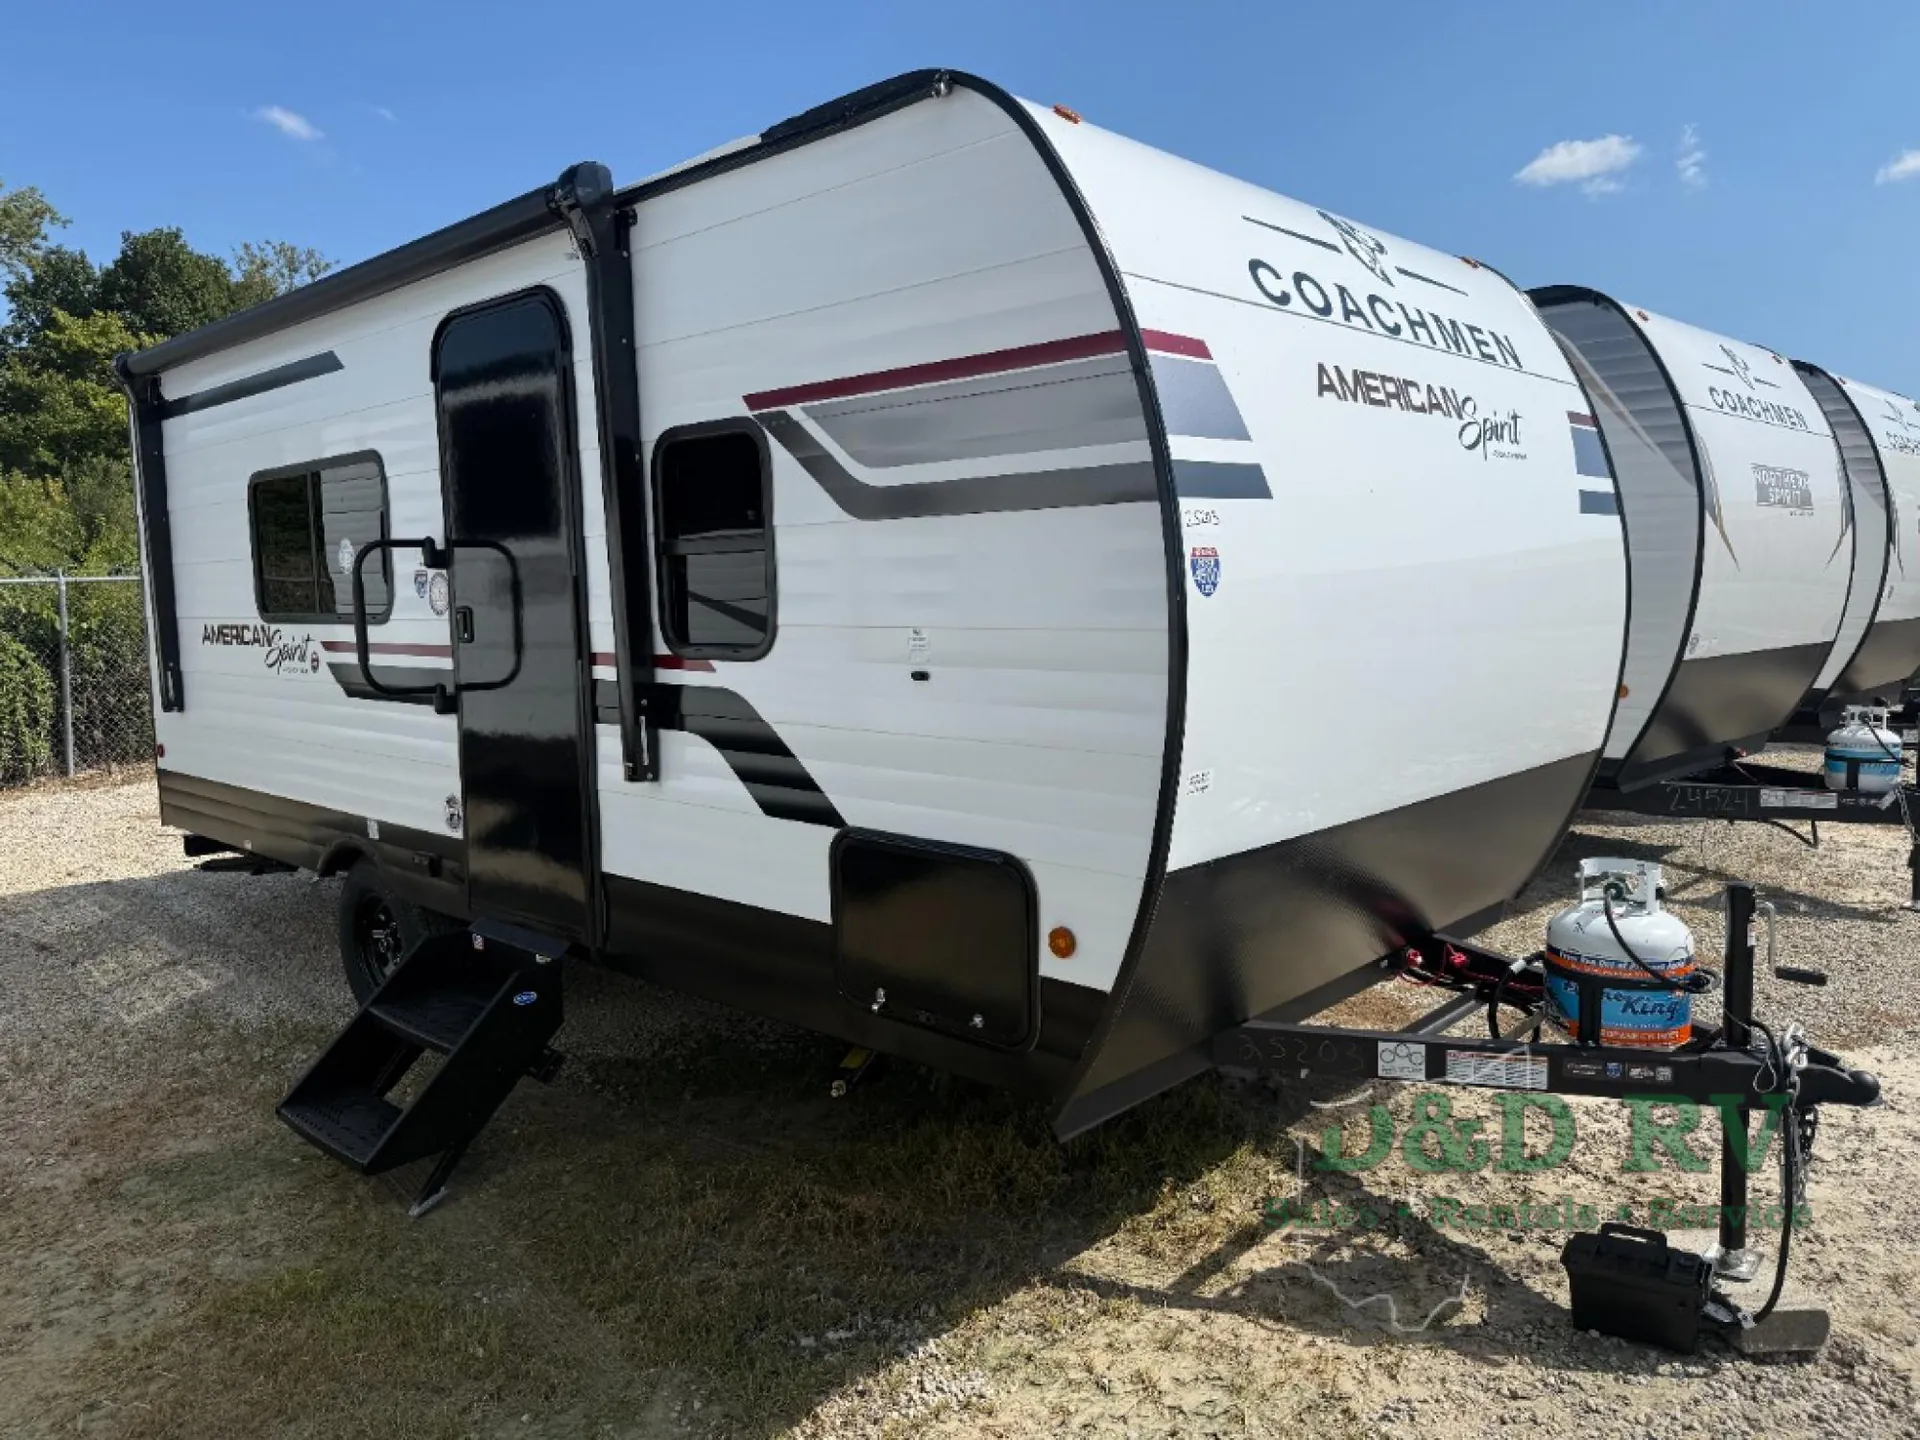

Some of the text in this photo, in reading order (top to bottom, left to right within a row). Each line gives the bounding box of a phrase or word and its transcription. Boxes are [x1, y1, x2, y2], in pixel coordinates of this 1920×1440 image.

[1247, 258, 1523, 369] COACHMEN
[1317, 361, 1522, 461] AMERICAN Spirit
[1707, 385, 1808, 430] COACHMEN
[202, 623, 272, 648] AMERICAN
[263, 629, 316, 676] Spirit
[1619, 996, 1680, 1020] King
